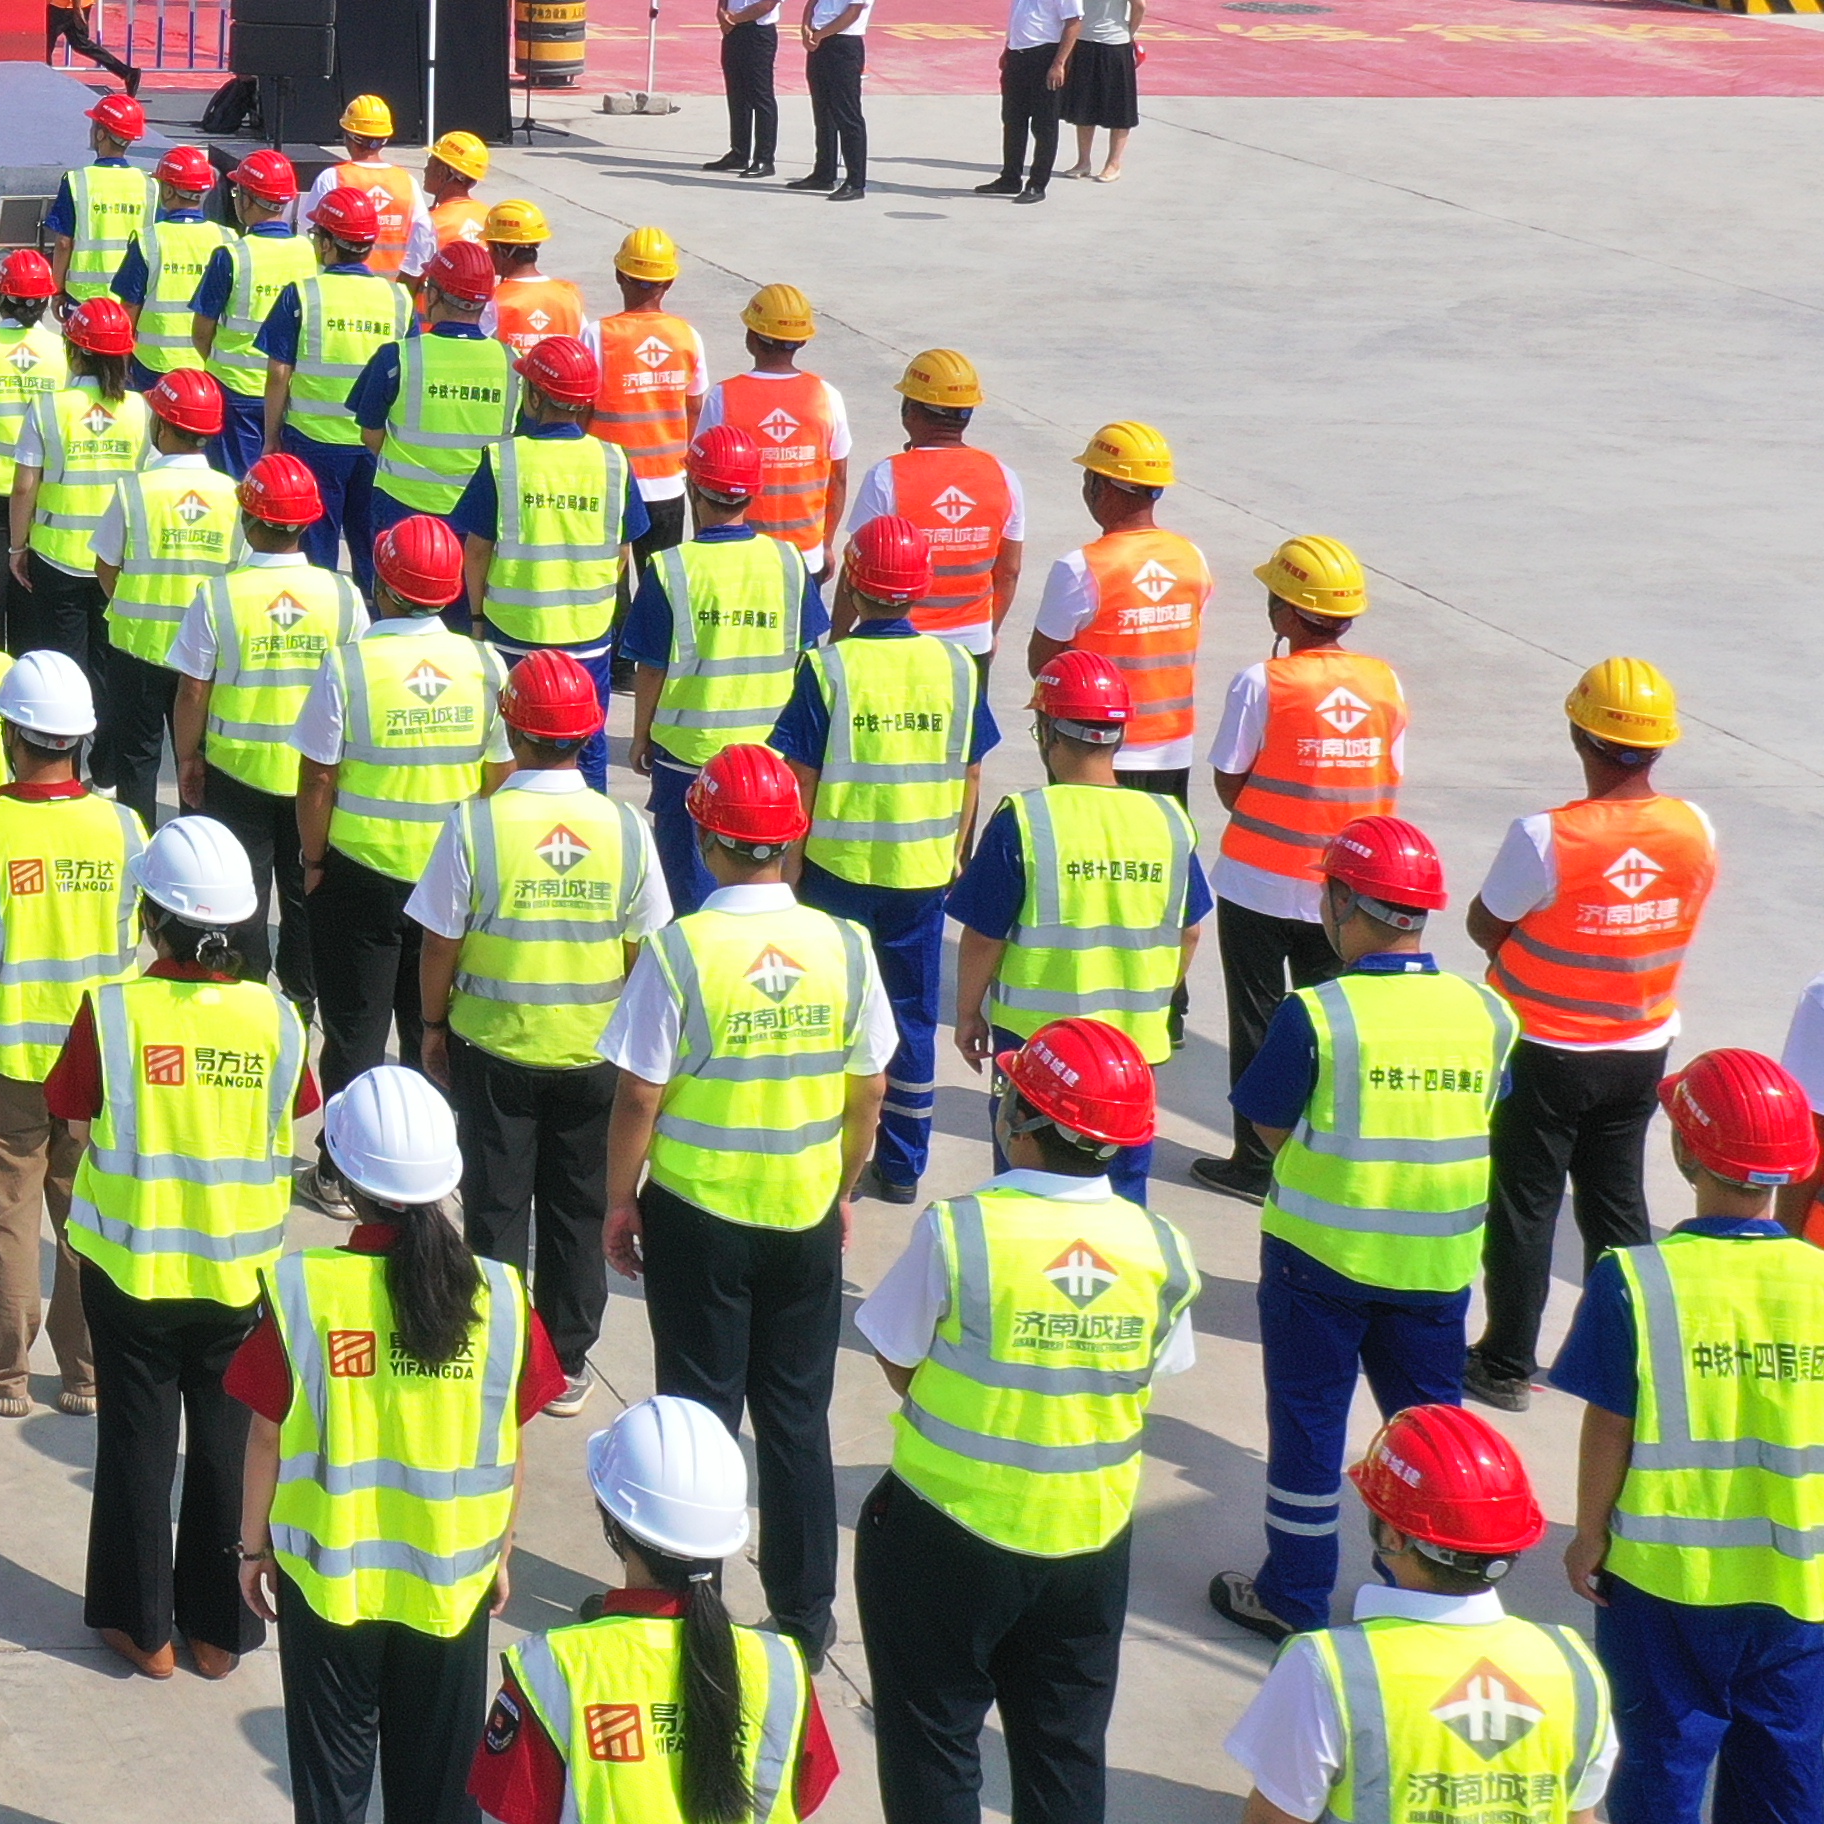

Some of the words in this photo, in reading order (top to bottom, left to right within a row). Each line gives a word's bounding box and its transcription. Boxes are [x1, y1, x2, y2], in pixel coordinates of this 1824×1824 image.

[428, 382, 502, 404] 中铁十四局集团
[523, 492, 600, 513] 中铁十四局集团
[697, 609, 779, 629] 中铁十四局集团
[1116, 602, 1193, 627] 济南城建
[250, 634, 326, 652] 济南城建
[386, 705, 474, 728] 济南城建
[852, 712, 944, 733] 中铁十四局集团
[1296, 737, 1382, 757] 济南城建
[54, 859, 116, 880] 易方达
[1066, 859, 1164, 884] 中铁十四局集团
[55, 880, 115, 894] YIFANGDA
[512, 878, 613, 901] 济南城建
[1575, 897, 1680, 926] 济南城建
[194, 1047, 265, 1076] 易方达
[196, 1074, 264, 1091] YIFANGDA
[1369, 1065, 1484, 1094] 中铁十四局集团
[1013, 1311, 1146, 1341] 济南城建
[390, 1361, 476, 1381] YIFANGDA
[1407, 1772, 1557, 1809] 济南城建
